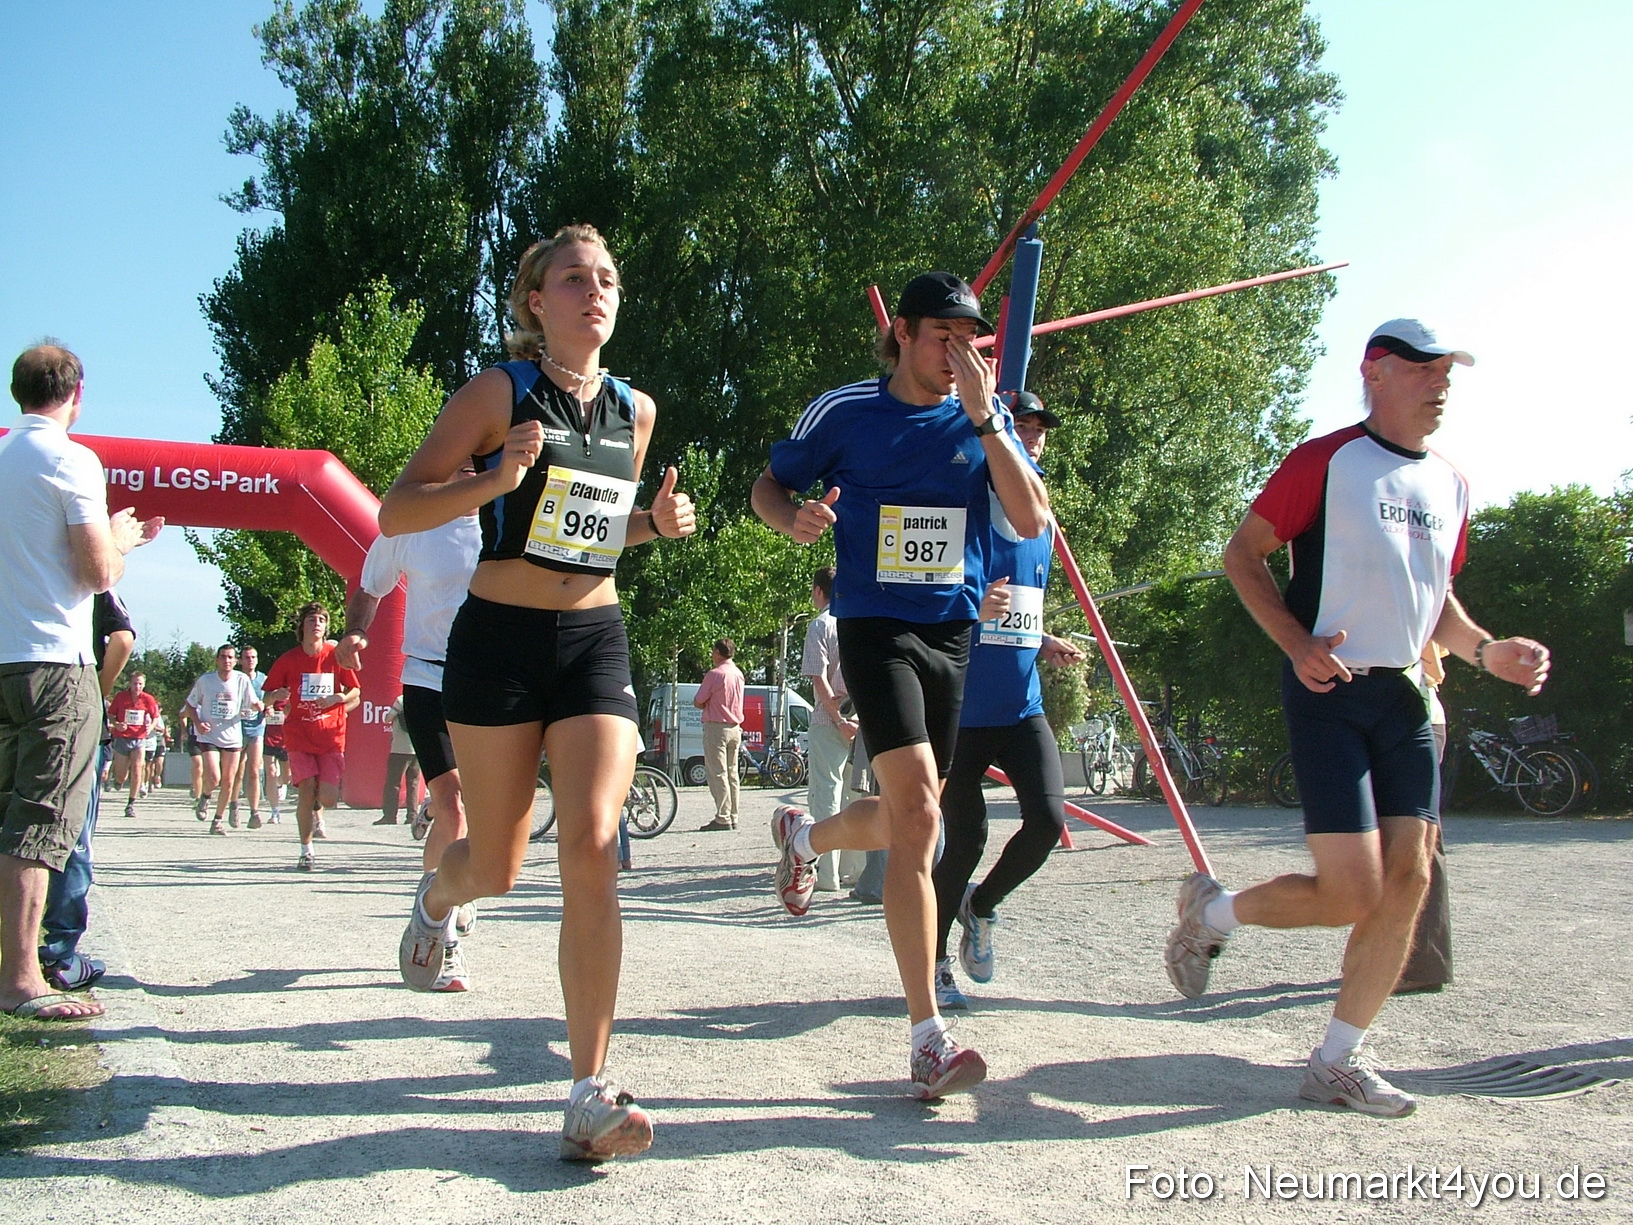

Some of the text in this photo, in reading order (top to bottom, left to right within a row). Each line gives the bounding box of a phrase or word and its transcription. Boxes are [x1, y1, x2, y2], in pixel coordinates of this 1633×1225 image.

[154, 466, 279, 494] LGS-Park
[569, 481, 619, 504] Claudia
[543, 500, 555, 514] B
[1379, 502, 1445, 532] ERDINGER
[562, 510, 610, 543] 986
[903, 516, 948, 530] patrick
[884, 535, 894, 547] C
[904, 541, 948, 563] 987
[1000, 611, 1039, 631] 2301
[310, 685, 332, 694] 2723
